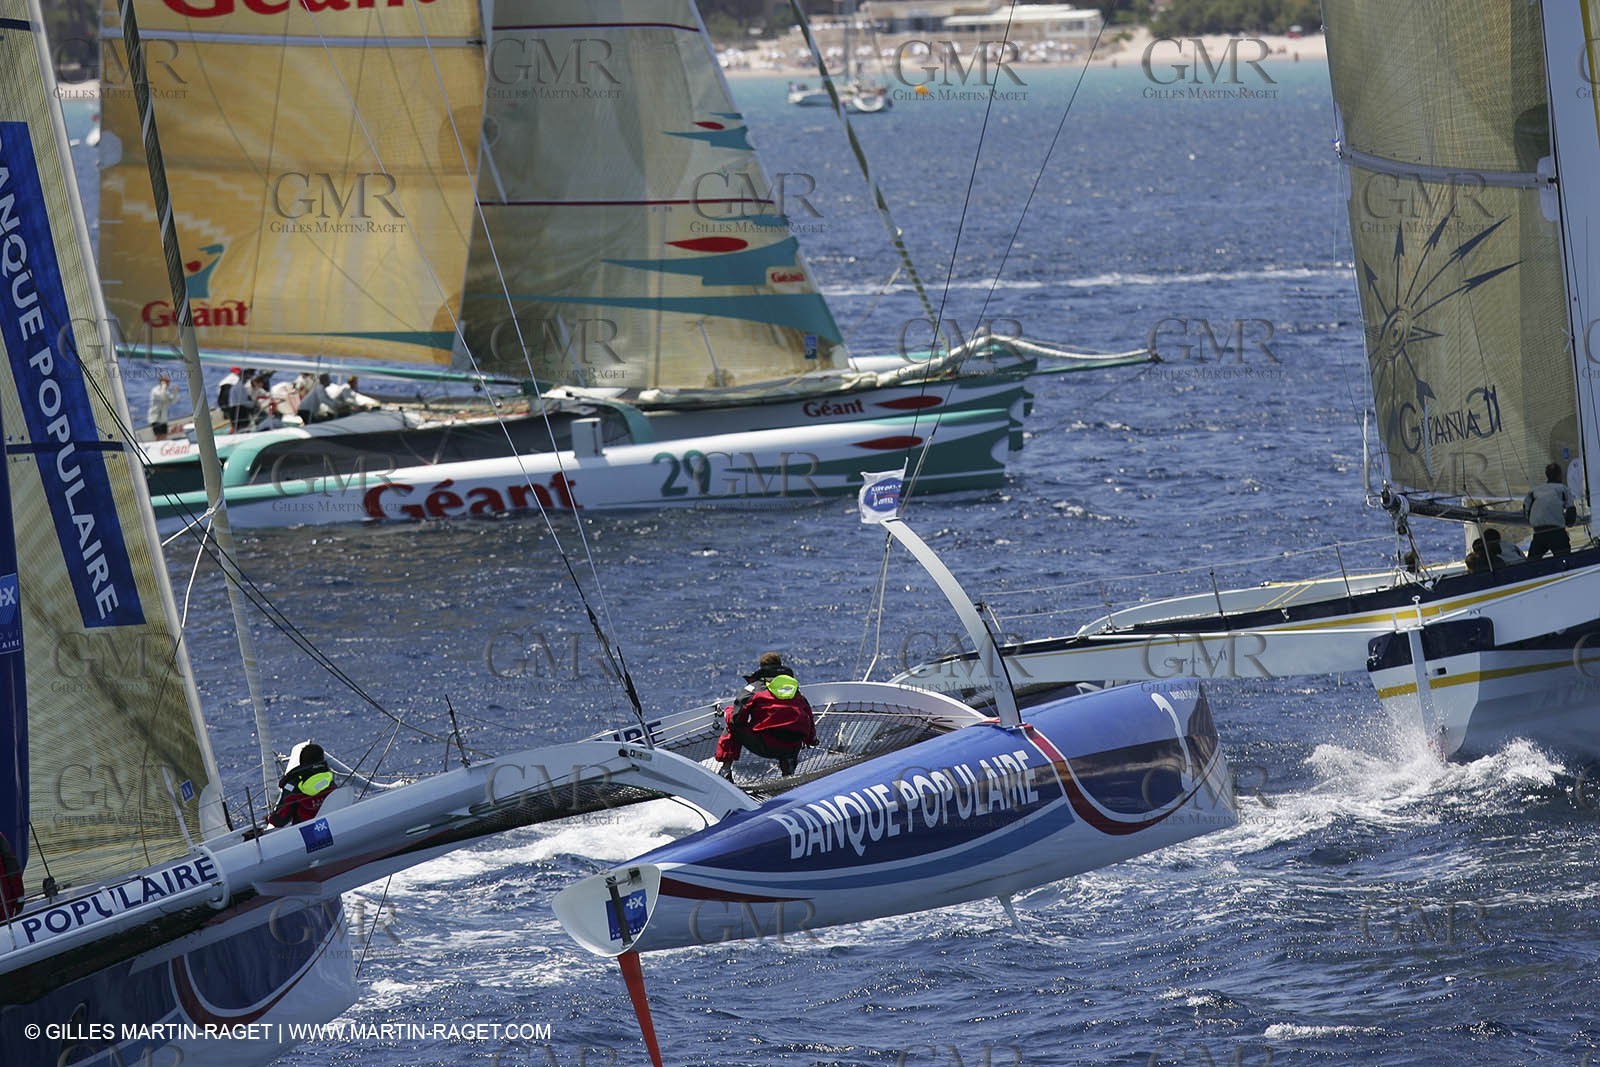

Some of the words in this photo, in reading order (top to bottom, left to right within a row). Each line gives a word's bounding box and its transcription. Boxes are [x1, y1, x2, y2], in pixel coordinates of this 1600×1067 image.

[142, 300, 249, 328] Gant
[803, 399, 864, 417] Géant
[29, 346, 119, 619] POPULAIRE
[363, 471, 583, 518] Géant
[652, 450, 711, 497] 29
[768, 783, 900, 859] BANQUE
[893, 750, 1039, 832] POPULAIRE
[22, 855, 218, 943] POPULAIRE
